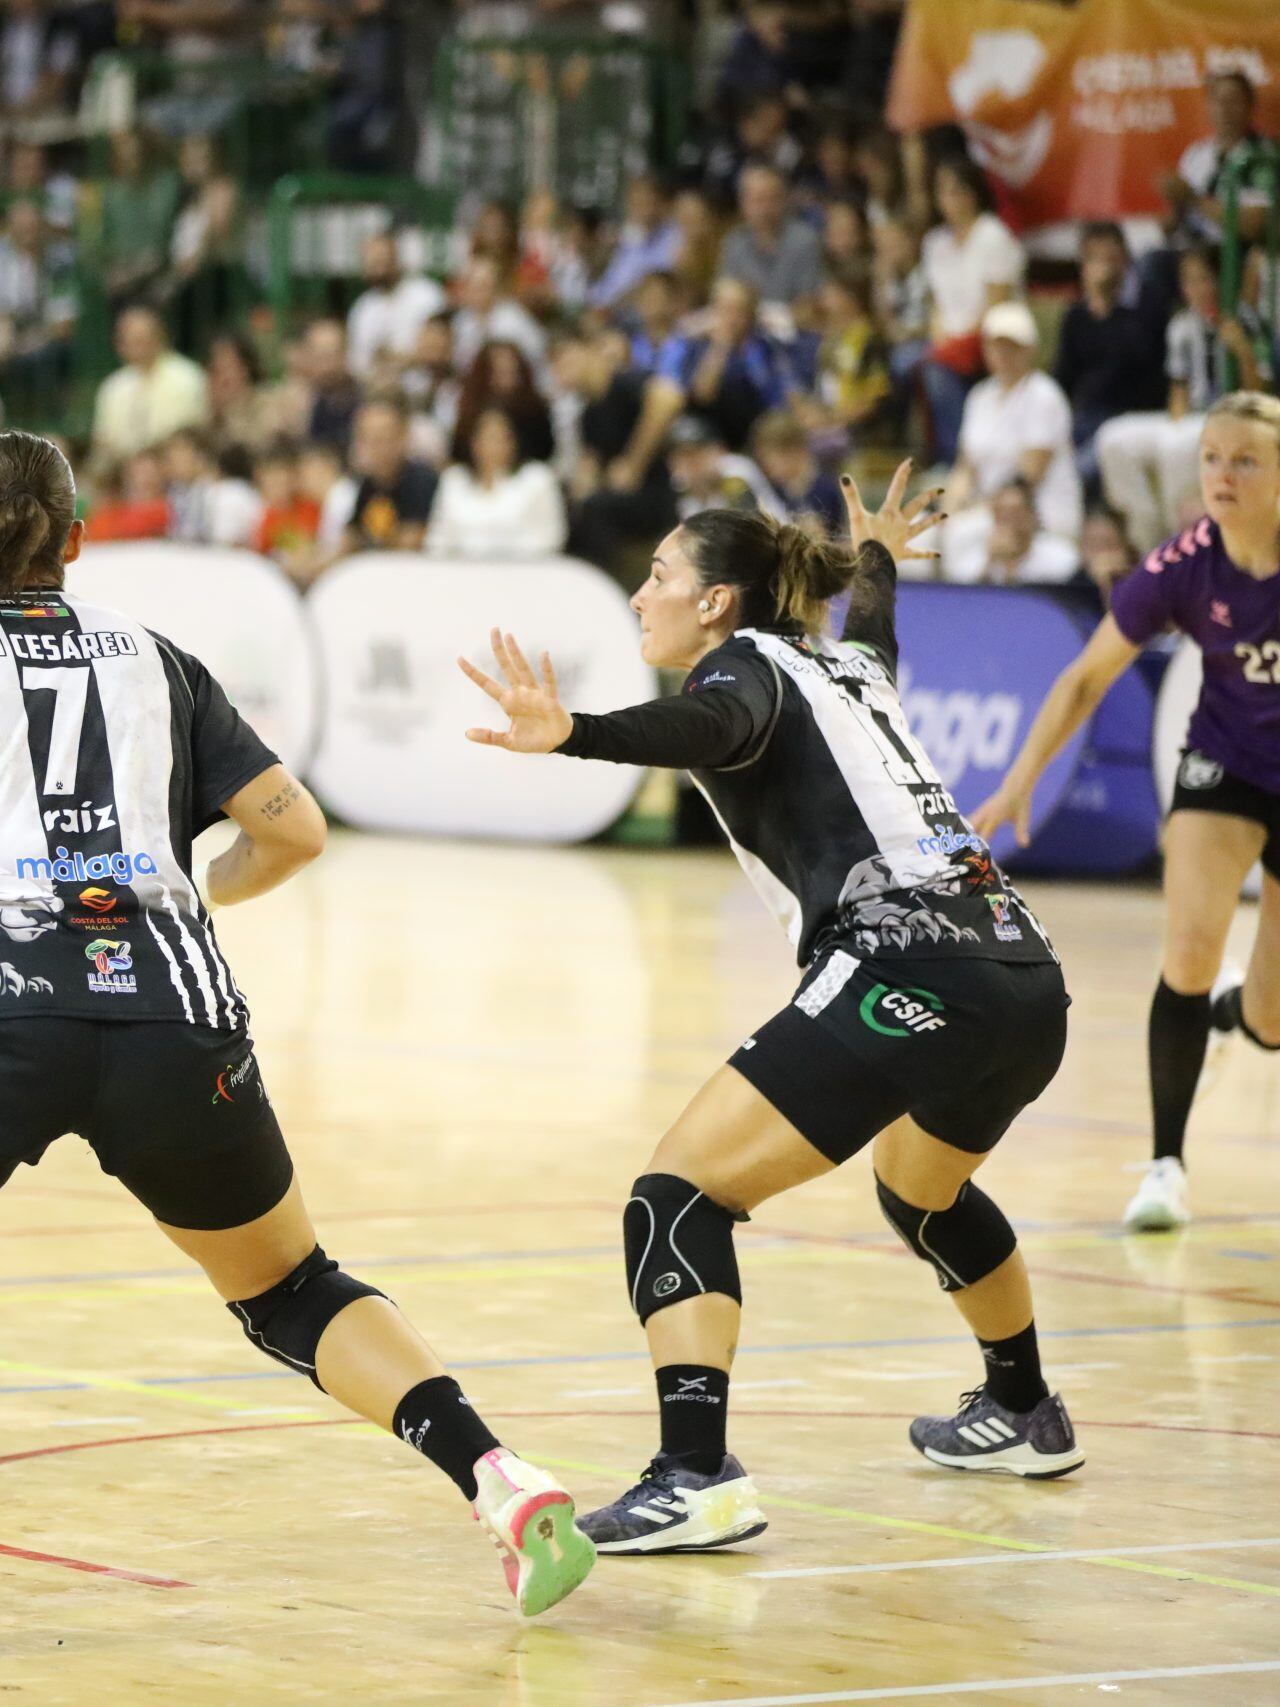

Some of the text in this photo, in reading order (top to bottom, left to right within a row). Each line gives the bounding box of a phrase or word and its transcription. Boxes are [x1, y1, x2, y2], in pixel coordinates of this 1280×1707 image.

[9, 630, 139, 661] CESÁREO
[22, 666, 91, 795] 7
[43, 801, 118, 833] raíz
[15, 845, 158, 886] málaga
[881, 992, 948, 1033] CSIF
